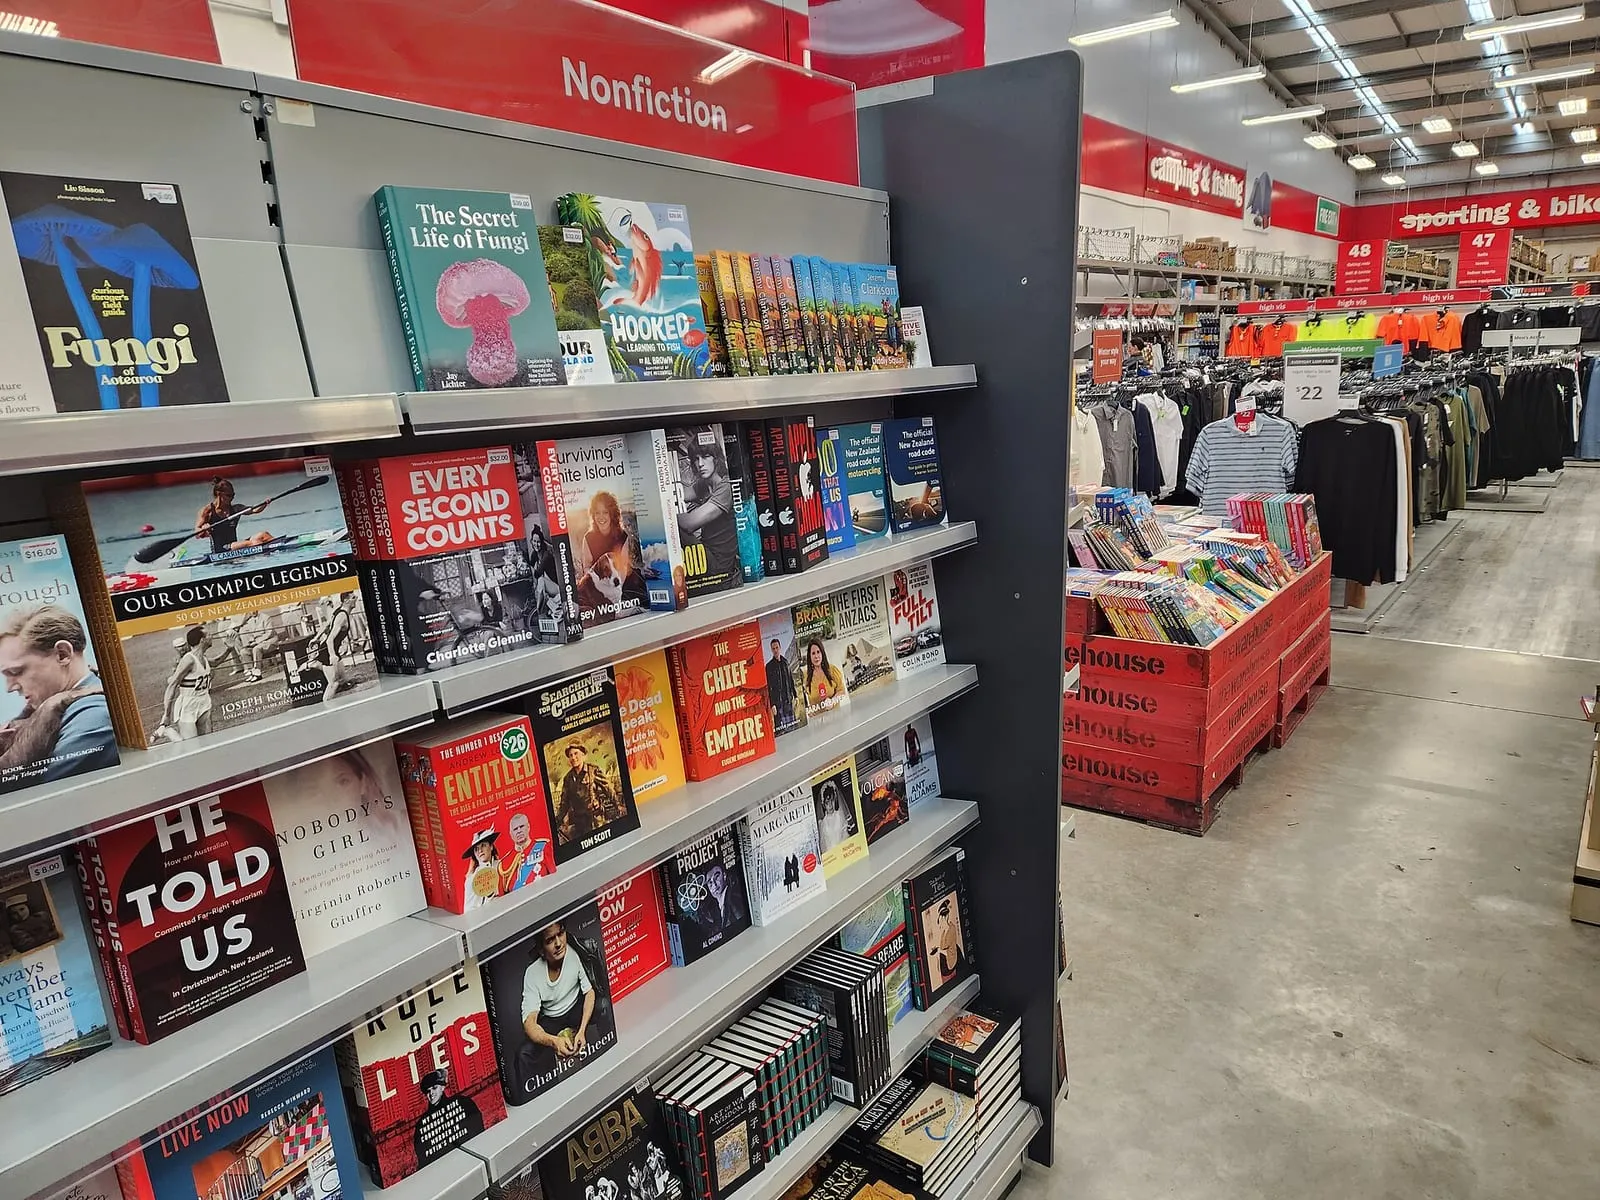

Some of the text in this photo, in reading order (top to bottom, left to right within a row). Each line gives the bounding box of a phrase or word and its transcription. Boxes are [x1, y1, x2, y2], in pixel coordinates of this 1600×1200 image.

[562, 56, 728, 132] Nonfiction
[1151, 155, 1244, 207] camping & fishing
[416, 204, 519, 228] The Secret
[1399, 203, 1511, 231] sporting
[1518, 199, 1541, 219] &
[410, 227, 530, 254] Life of Fungi
[1348, 244, 1371, 258] 48
[1472, 233, 1496, 248] 47
[104, 279, 111, 287] A
[861, 283, 897, 297] Clarkson
[867, 273, 886, 284] Jeremy
[1258, 302, 1286, 312] high vis
[1422, 293, 1454, 302] high vis
[103, 308, 125, 316] guide
[610, 312, 690, 342] HOOKED
[44, 323, 198, 375] Fungi
[627, 342, 681, 352] LEARNING TO FISH
[652, 356, 673, 364] BROWN
[100, 374, 163, 386] Aotearoa
[124, 367, 135, 375] of
[1296, 386, 1322, 400] $22
[788, 423, 817, 463] APPLE
[850, 436, 880, 447] The official
[911, 438, 934, 447] Zealand
[913, 429, 933, 438] official
[490, 454, 509, 463] $32.00
[846, 446, 880, 458] New Zealand
[847, 456, 881, 468] road code for
[909, 448, 935, 458] road code
[409, 464, 492, 495] EVERY
[585, 462, 625, 479] Island
[848, 468, 881, 479] motorcycling
[542, 467, 555, 513] COUNTS
[547, 447, 566, 529] EVERY SECOND
[830, 488, 841, 503] US
[401, 489, 510, 524] SECOND
[730, 478, 749, 532] Jump In
[407, 514, 515, 551] COUNTS
[25, 548, 58, 559] $16.00
[218, 546, 263, 560] CARRINGTON
[124, 560, 348, 613] OUR OLYMPIC LEGENDS
[830, 583, 879, 612] THE FIRST
[176, 587, 322, 623] 50 OF NEW ZEALAND'S FINEST
[597, 597, 640, 616] Waghorn
[796, 604, 830, 625] BRAVE
[839, 605, 877, 630] ANZACS
[894, 588, 928, 625] FULL
[907, 597, 934, 632] TILT
[426, 630, 533, 665] Charlotte Glennie
[714, 642, 729, 656] THE
[1234, 614, 1274, 658] warehouse
[902, 658, 921, 668] COLIN
[922, 650, 939, 661] BOND
[1065, 643, 1165, 675] ehouse
[703, 660, 747, 695] CHIEF
[221, 681, 322, 715] JOSEPH ROMANOS
[539, 682, 603, 718] FOR CHARLIE
[628, 692, 663, 714] Dead
[715, 695, 746, 716] AND THE
[1228, 680, 1269, 732] warehouse
[503, 733, 526, 753] $26
[705, 714, 764, 757] EMPIRE
[1062, 715, 1157, 748] ehouse
[440, 735, 487, 760] THE NUMBER 1
[2, 767, 49, 783] Daily Telegraph
[443, 752, 535, 806] ENTITLED
[1062, 752, 1160, 787] ehouse
[911, 779, 926, 793] ANT
[153, 794, 227, 853] HE
[276, 796, 394, 847] NOBODY'S
[314, 829, 369, 860] GIRL
[580, 829, 612, 849] TOM SCOTT
[164, 860, 181, 868] How
[194, 840, 229, 858] Australian
[299, 843, 398, 884] Memoir Surviving Abuse
[677, 841, 719, 875] PROJECT
[126, 846, 270, 928] TOLD
[304, 857, 391, 894] and Fighting for Justice
[357, 870, 411, 897] Roberts
[932, 881, 946, 893] Tea
[154, 889, 263, 939] Committed Far-Right Terrorism
[330, 901, 382, 929] Giuffre
[108, 922, 123, 953] US
[180, 913, 253, 972] US
[617, 933, 636, 947] THINGS
[181, 967, 230, 994] Christchurch,
[231, 961, 246, 971] New
[247, 947, 274, 963] Zealand
[617, 955, 639, 973] BRYANT
[15, 985, 73, 1019] Name
[23, 1018, 32, 1030] of
[409, 1013, 438, 1044] OF
[376, 1022, 480, 1102] LIES
[524, 1030, 615, 1094] Charlie Sheen
[709, 1110, 724, 1124] ART
[715, 1104, 744, 1126] WISDOM
[856, 1076, 912, 1131] ANCIENT WARFARE
[160, 1094, 250, 1158] LIVE NOW
[566, 1098, 648, 1183] ABBA
[823, 1160, 852, 1187] OF THE
[832, 1165, 864, 1195] INCA
